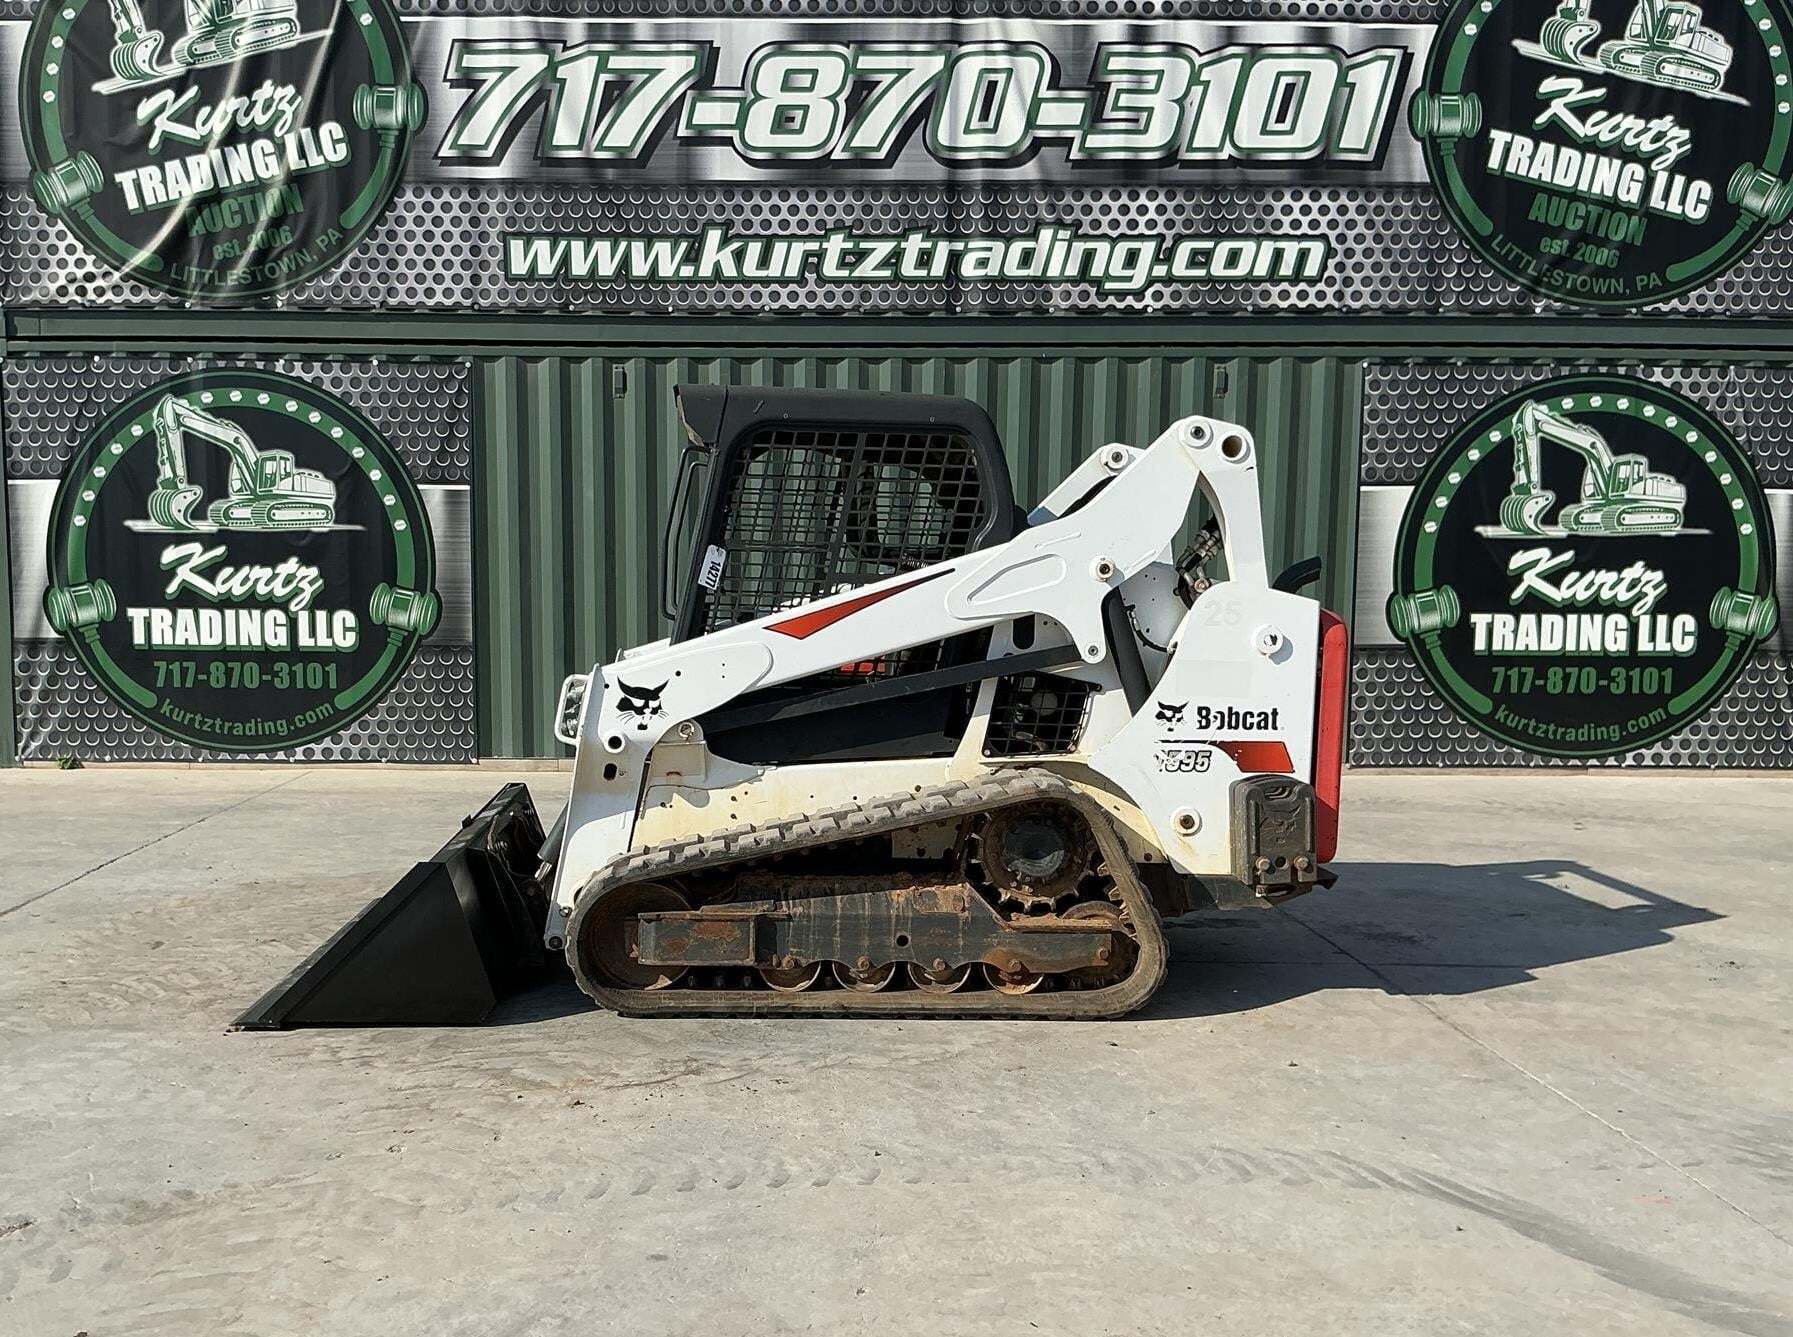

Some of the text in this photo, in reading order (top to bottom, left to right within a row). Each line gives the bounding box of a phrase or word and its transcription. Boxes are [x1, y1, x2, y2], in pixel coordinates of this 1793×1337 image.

[136, 80, 302, 152] Kurtz
[444, 44, 1402, 161] 717-870-3101
[1535, 76, 1692, 172] Kurtz
[114, 121, 350, 213] TRADING LLC
[1487, 129, 1713, 221] TRADING LLC
[186, 184, 304, 238] AUCTION
[1529, 193, 1648, 246] AUCTION
[315, 228, 344, 251] PA
[506, 226, 1328, 292] www.kurtztrading.com
[1573, 242, 1621, 268] 2006
[1635, 273, 1663, 292] PA
[160, 542, 324, 612] Kurtz
[1508, 547, 1668, 617] Kurtz
[126, 607, 358, 650] TRADING LLC
[1470, 613, 1697, 654] TRADING LLC
[153, 661, 337, 689] 717-870-3101
[1491, 667, 1673, 694] 717-870-3101
[160, 698, 334, 736] kurtztrading.com
[1196, 706, 1279, 731] Bobcat
[1494, 703, 1668, 742] kurtztrading.com
